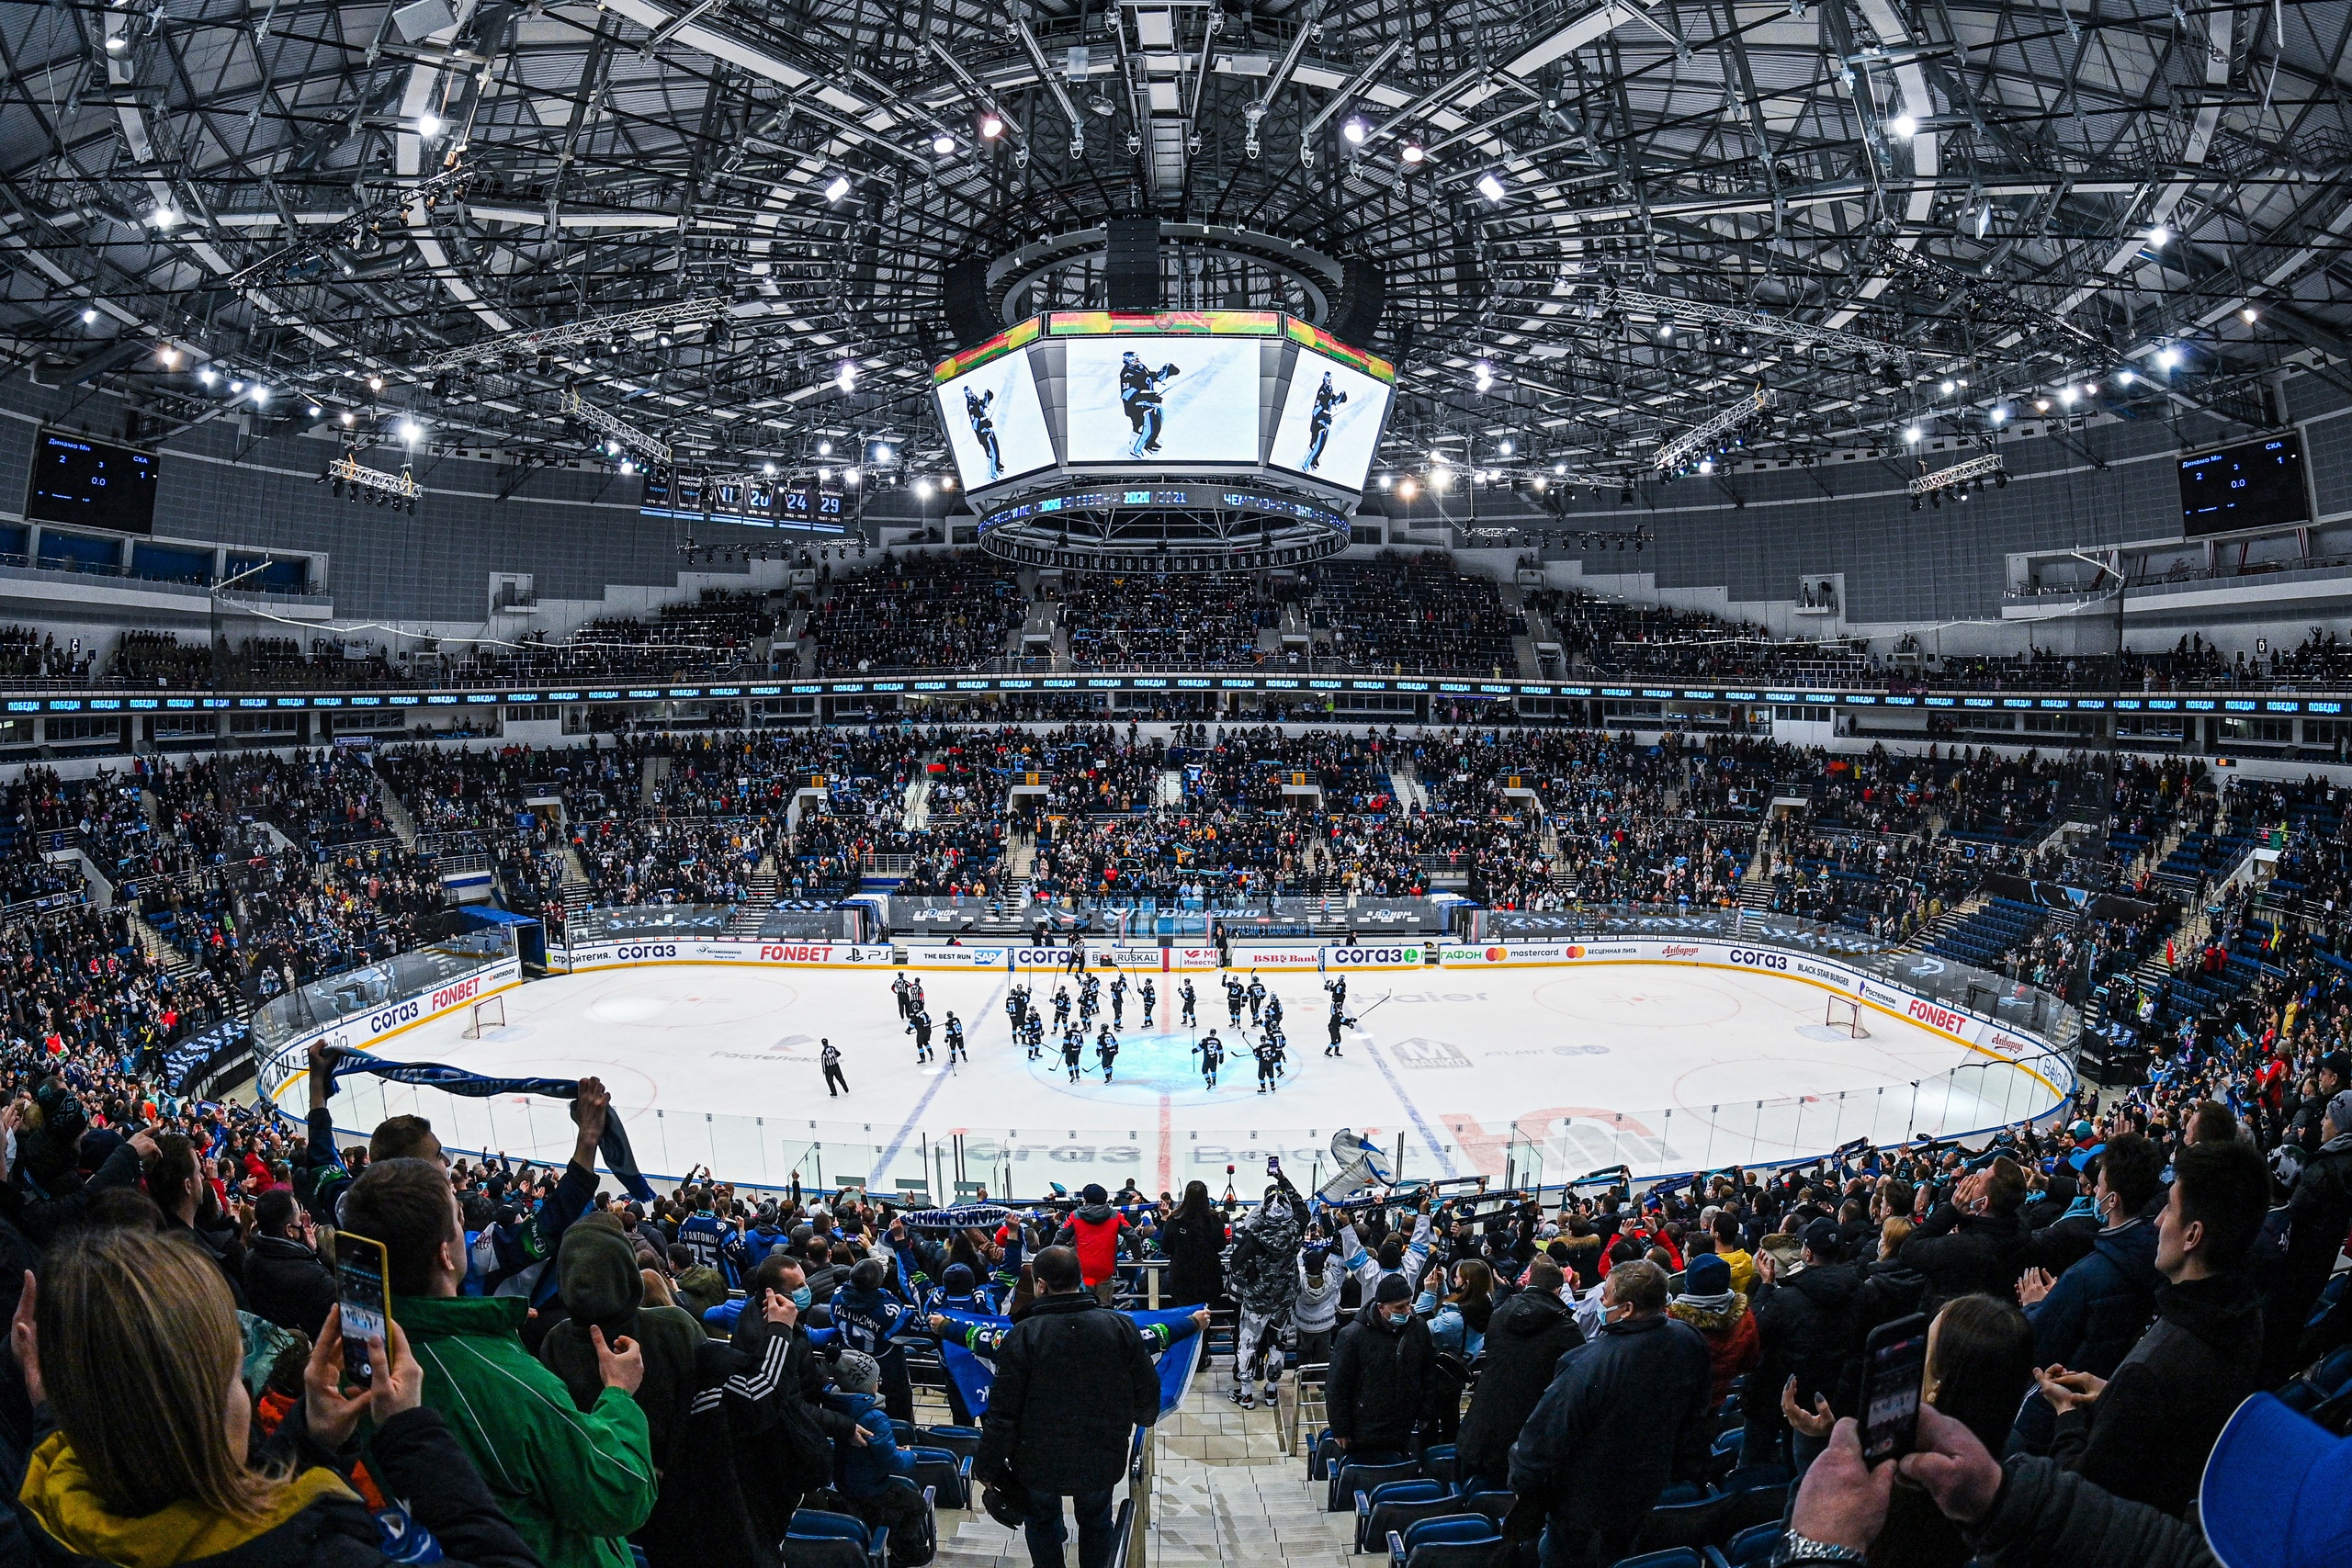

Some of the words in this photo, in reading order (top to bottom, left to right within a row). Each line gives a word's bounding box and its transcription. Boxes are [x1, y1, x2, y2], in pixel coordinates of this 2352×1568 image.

[48, 438, 78, 450] Динамо
[2265, 442, 2282, 450] СКА
[59, 455, 66, 463] 2
[133, 456, 148, 464] СКА
[2182, 457, 2210, 469] Динамо
[91, 477, 106, 486] 0.0
[2231, 479, 2245, 489] 0.0
[787, 494, 807, 510] 24
[820, 497, 840, 513] 29
[874, 682, 903, 692] ПОБЕДА!
[957, 681, 988, 690] ПОБЕДА!
[1000, 680, 1032, 689] ПОБЕДА!
[1088, 679, 1121, 688] ПОБЕДА!
[1221, 679, 1254, 688] ПОБЕДА!
[1267, 680, 1298, 688] ПОБЕДА!
[1353, 681, 1385, 690] ПОБЕДА!
[1396, 682, 1428, 691] ПОБЕДА!
[709, 688, 740, 696] ПОБЕДА!
[752, 686, 780, 695] ПОБЕДА!
[1481, 684, 1510, 694] ПОБЕДА!
[1521, 686, 1550, 695] ПОБЕДА!
[1601, 688, 1631, 697] ПОБЕДА!
[1643, 689, 1672, 698] ПОБЕДА!
[588, 691, 618, 699] ПОБЕДА!
[629, 690, 659, 698] ПОБЕДА!
[1765, 693, 1795, 702] ПОБЕДА!
[130, 699, 157, 709] ПОБЕДА!
[239, 698, 266, 707] ПОБЕДА!
[277, 697, 304, 707] ПОБЕДА!
[352, 697, 379, 705] ПОБЕДА!
[389, 696, 418, 705] ПОБЕДА!
[1846, 695, 1875, 705] ПОБЕДА!
[1886, 696, 1914, 705] ПОБЕДА!
[1964, 698, 1993, 707] ПОБЕДА!
[2003, 698, 2031, 708] ПОБЕДА!
[7, 701, 40, 713] ПОБЕДА!
[50, 700, 80, 711] ПОБЕДА!
[2186, 700, 2214, 711] ПОБЕДА!
[2225, 700, 2256, 712] ПОБЕДА!
[2308, 702, 2341, 714] ПОБЕДА!
[2272, 836, 2281, 849] D
[760, 945, 833, 962] FONBET
[1019, 950, 1072, 964] сога
[1092, 953, 1159, 962] BRUSKALI
[1510, 949, 1559, 957] mastercard
[975, 952, 999, 964] SAP
[1797, 964, 1816, 974] BLACK
[1817, 968, 1830, 980] STAR
[1830, 972, 1849, 987] BURGER
[432, 976, 481, 1011] FONBET
[1865, 986, 1897, 1005] Ростелеком
[1908, 999, 1966, 1034] FONBET
[906, 1209, 1007, 1227] ИНАМО-МИНС
[686, 1243, 718, 1271] 75
